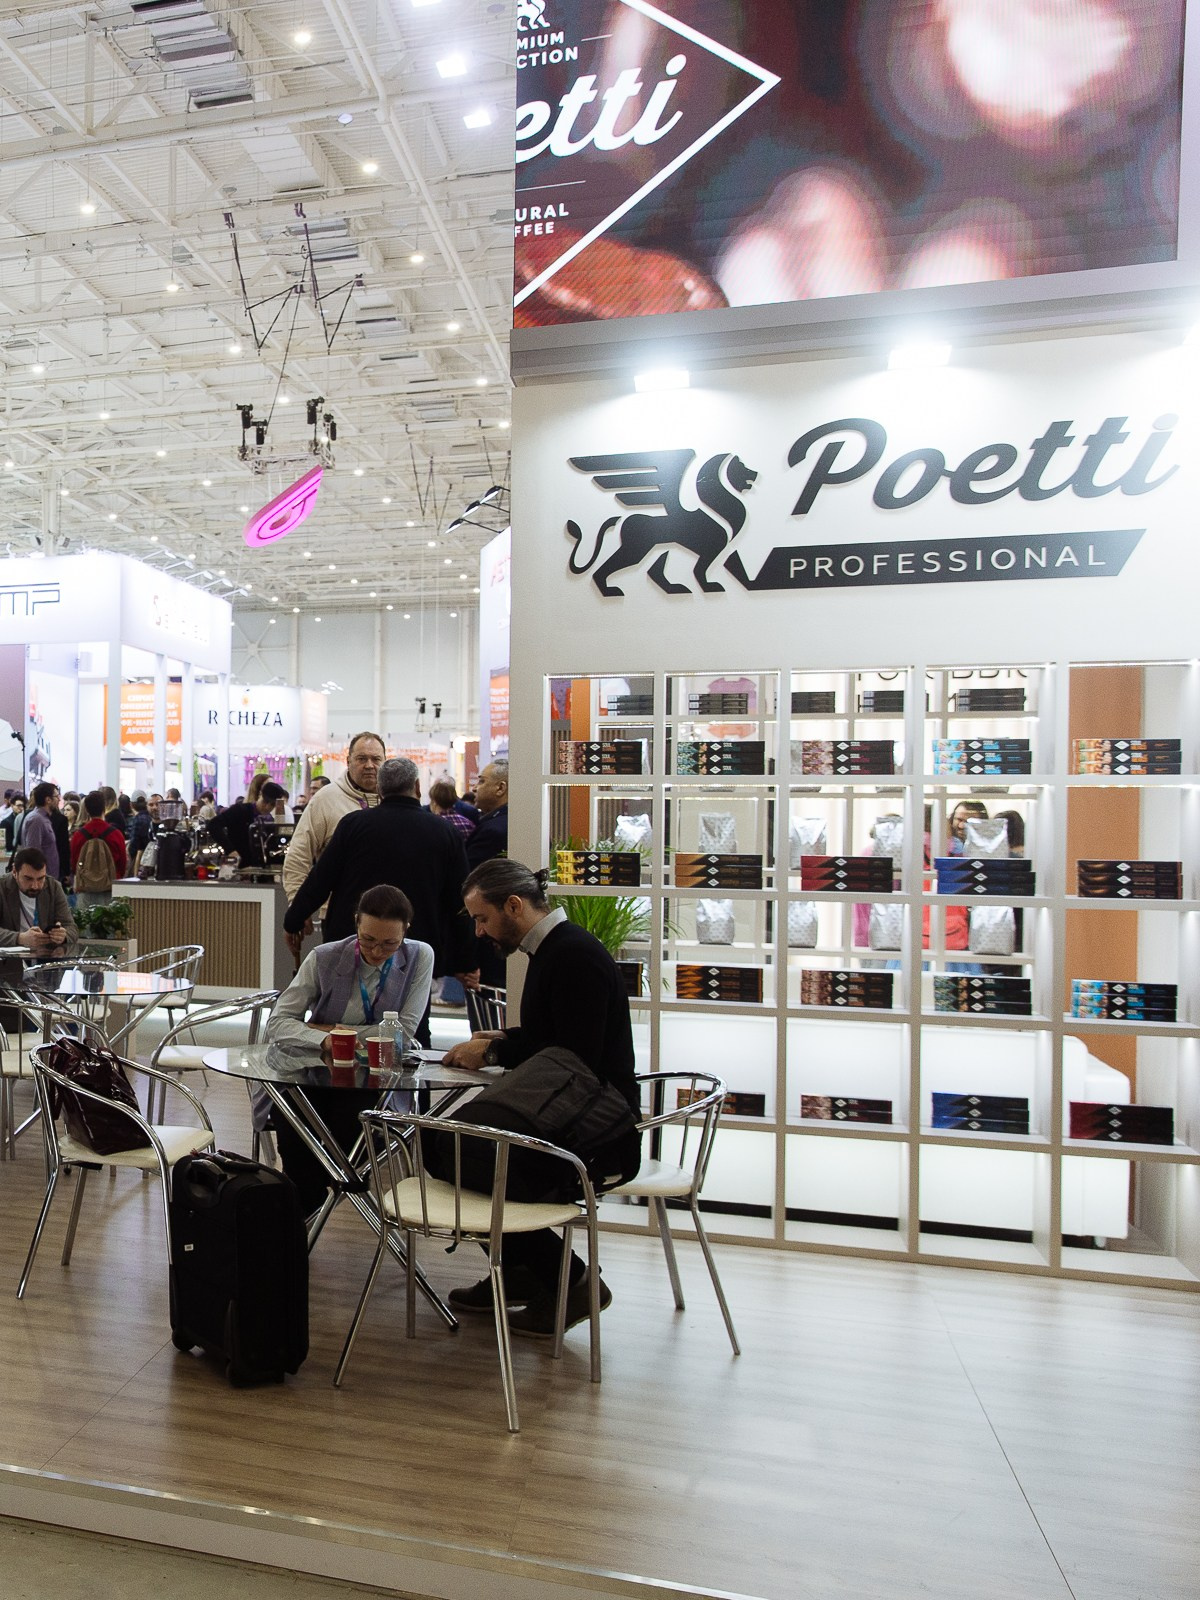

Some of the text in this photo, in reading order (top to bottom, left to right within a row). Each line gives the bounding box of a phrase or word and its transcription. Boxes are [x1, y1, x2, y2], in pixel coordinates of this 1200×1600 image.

[787, 413, 1181, 516] Poetti
[789, 544, 1107, 579] PROFESSIONAL
[208, 709, 283, 727] RCHEZA
